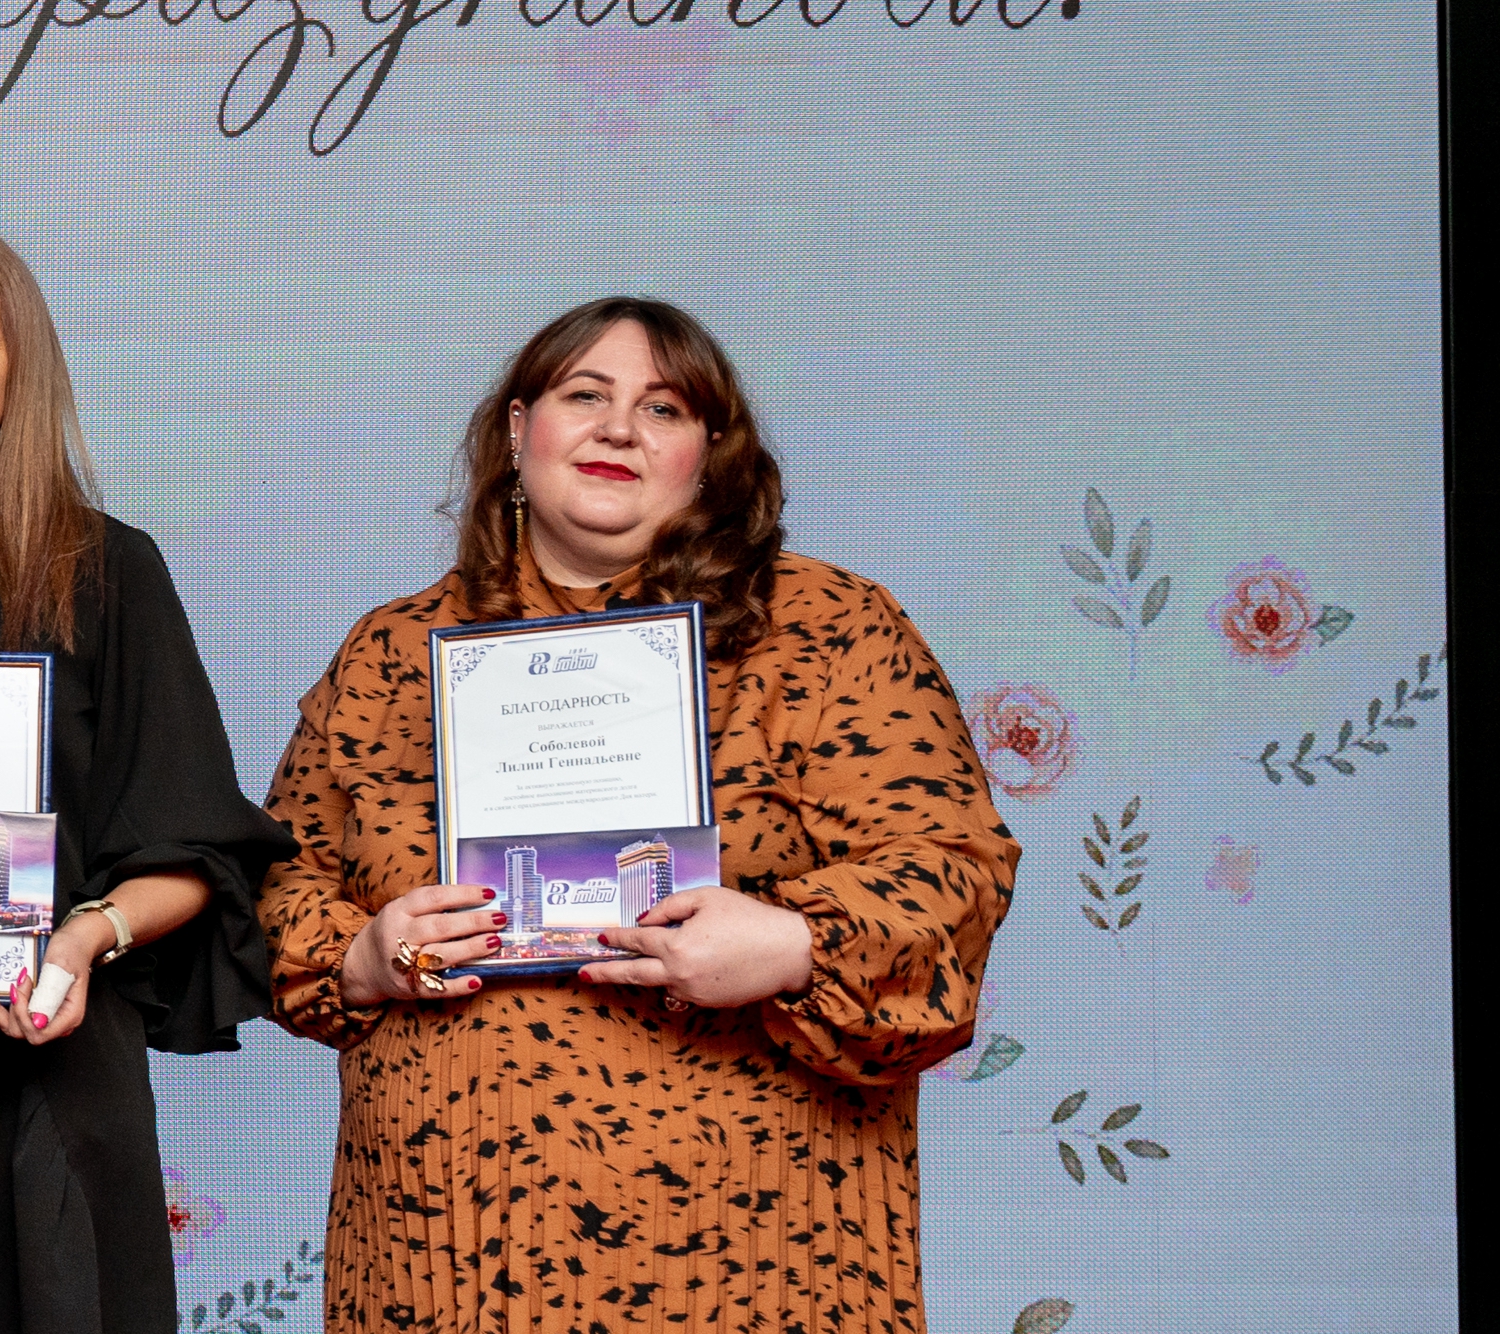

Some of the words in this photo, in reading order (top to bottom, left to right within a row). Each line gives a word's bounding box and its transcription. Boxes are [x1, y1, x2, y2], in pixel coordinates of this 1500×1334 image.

[501, 692, 631, 716] БЛАГОДАРНОСТЬ
[528, 736, 606, 754] Соболевой
[495, 761, 544, 774] Лилии
[548, 752, 642, 769] Геннадьевне
